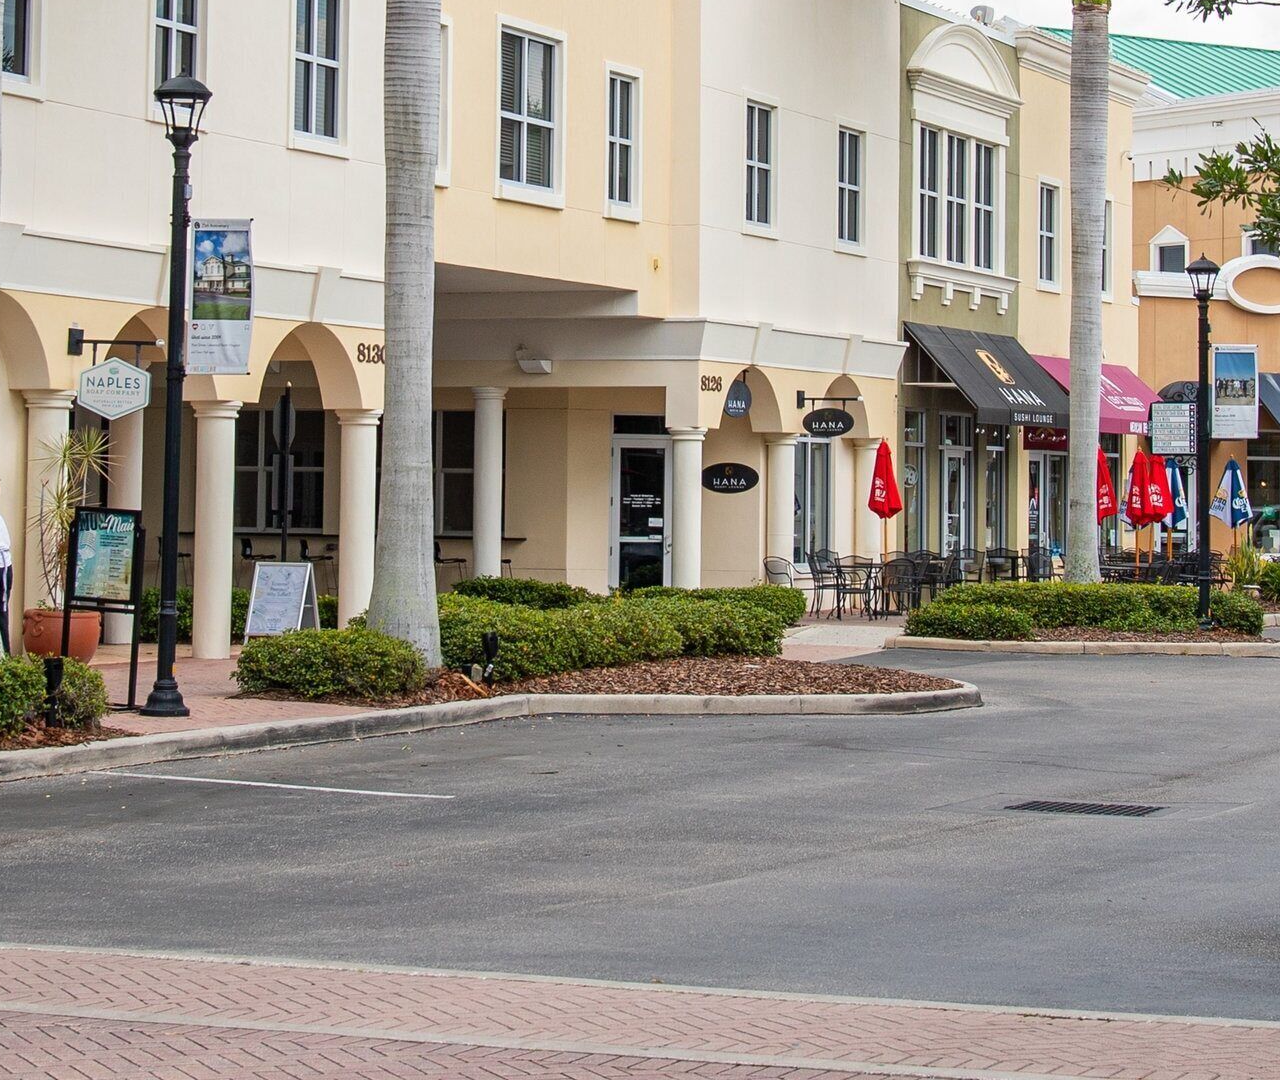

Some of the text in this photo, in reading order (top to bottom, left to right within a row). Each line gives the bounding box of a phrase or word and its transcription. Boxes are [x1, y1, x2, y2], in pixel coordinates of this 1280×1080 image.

[86, 376, 141, 389] NAPLES
[701, 375, 723, 392] 8126
[106, 389, 141, 397] COMPANY
[998, 387, 1047, 407] HANA
[727, 400, 746, 409] HANA
[1014, 412, 1053, 424] SUSHI LOUNGE
[812, 421, 844, 429] HANA
[713, 478, 747, 486] HANA
